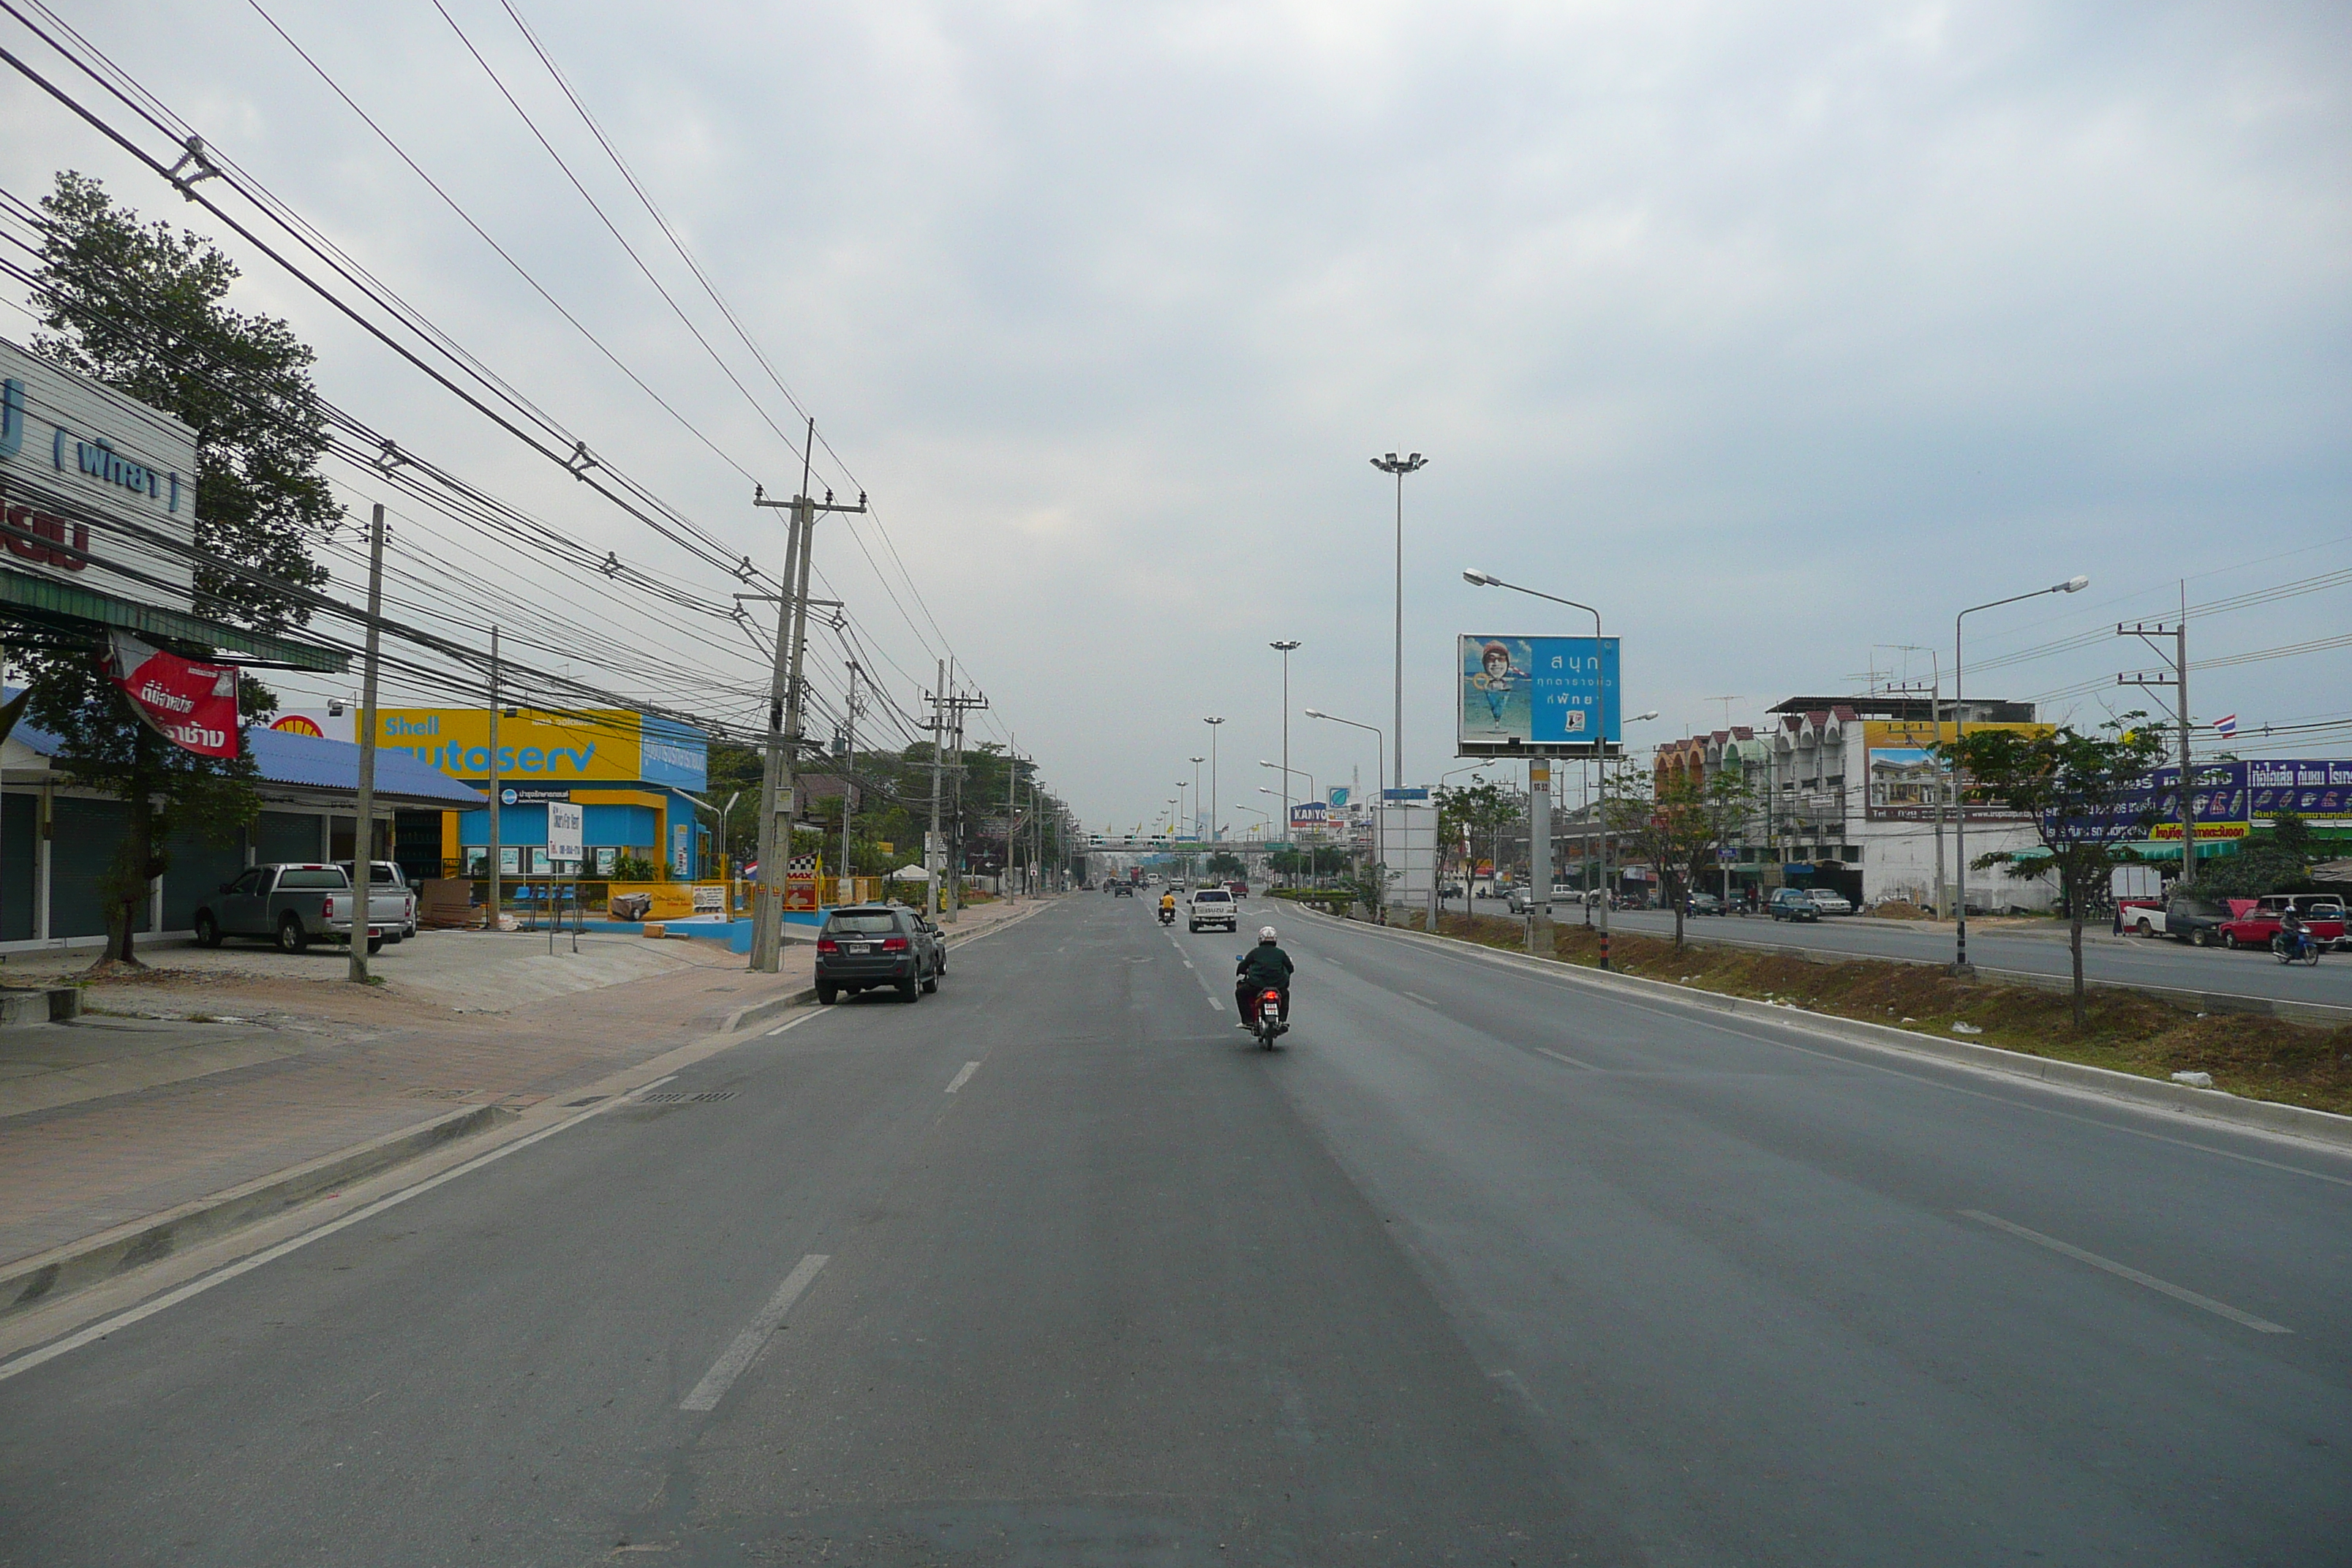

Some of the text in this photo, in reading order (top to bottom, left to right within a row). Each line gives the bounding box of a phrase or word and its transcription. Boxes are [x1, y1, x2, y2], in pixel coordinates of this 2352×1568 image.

[1551, 655, 1599, 673] สนุก
[1547, 693, 1601, 704] ที่พัทย
[385, 715, 440, 736] Shell
[2253, 761, 2293, 787] ท่อไอเสีย
[2298, 764, 2325, 785] กันชน
